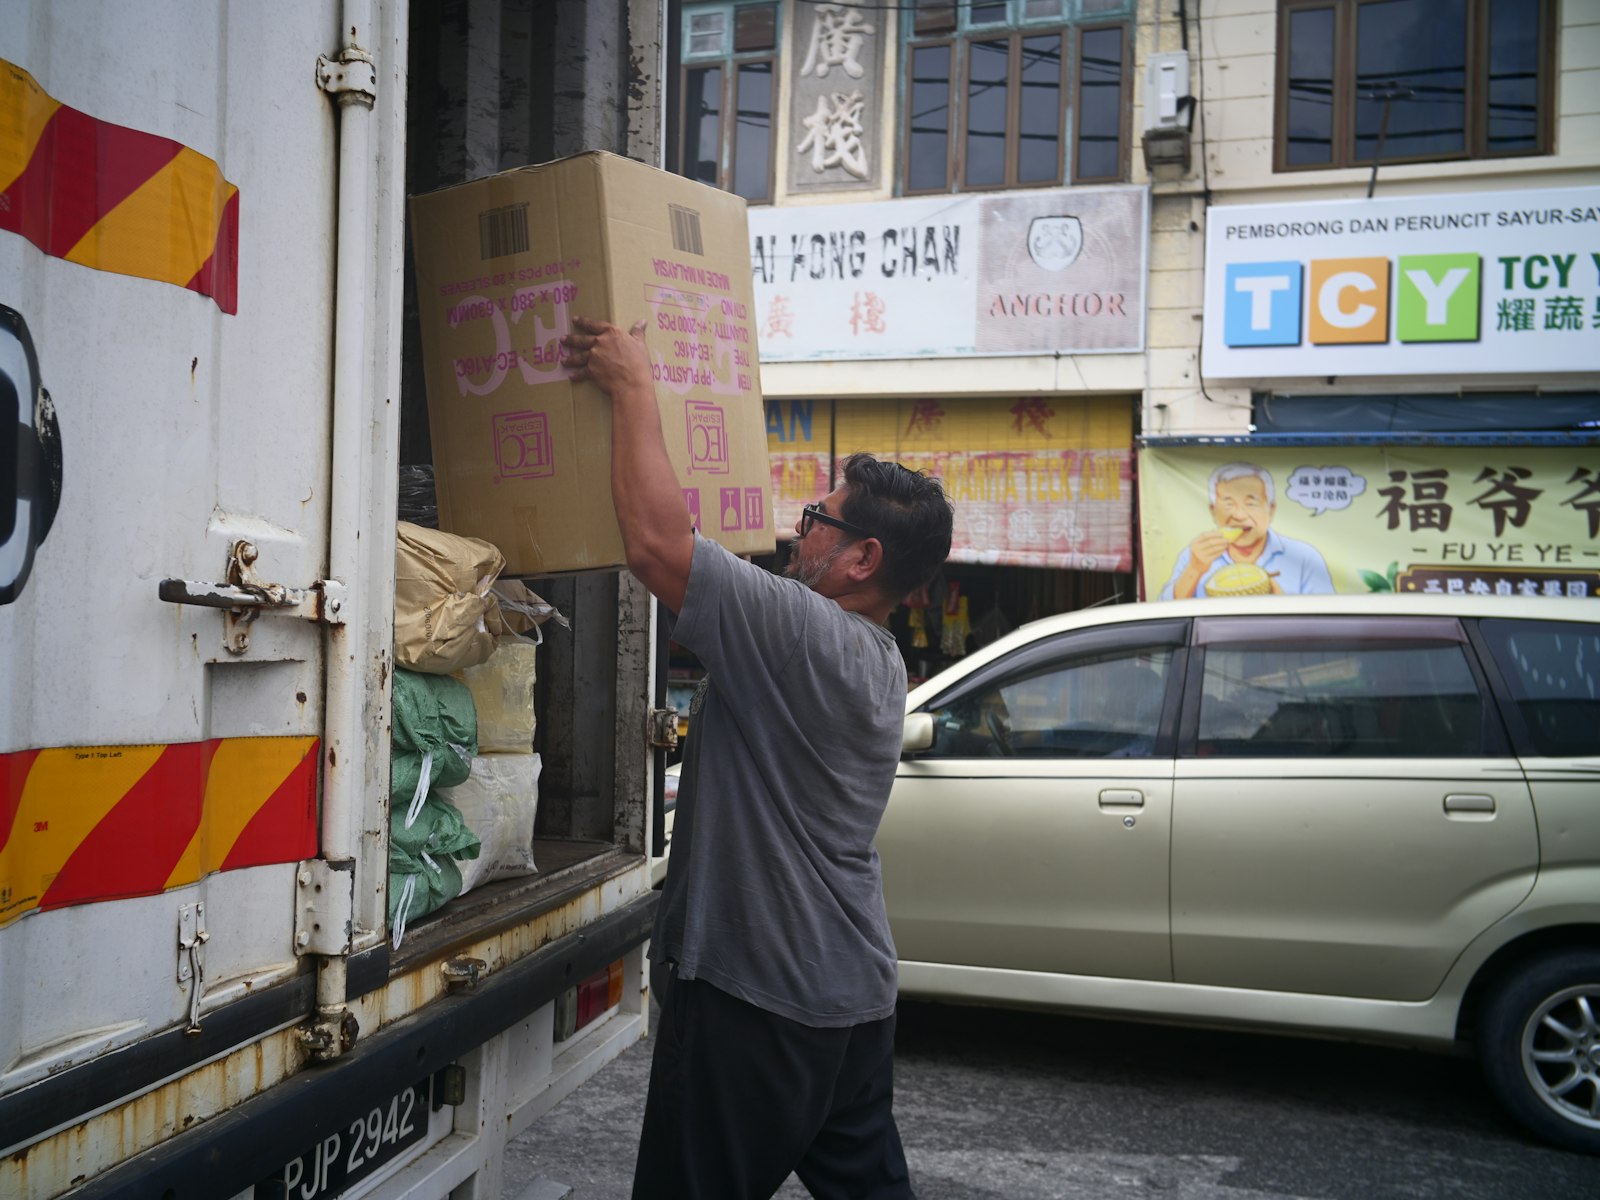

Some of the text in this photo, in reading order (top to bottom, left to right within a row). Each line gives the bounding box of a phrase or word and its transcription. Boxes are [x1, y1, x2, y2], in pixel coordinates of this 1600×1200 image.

[1226, 207, 1600, 240] PEMBORONG DAN PERUNCIT SAYUR-SA
[881, 225, 960, 278] CHAN
[519, 267, 542, 281] PCS
[652, 257, 697, 283] MALAYSIA
[1498, 254, 1577, 290] TCY
[440, 277, 490, 297] SLEEVES
[707, 270, 730, 291] MADE
[511, 292, 536, 312] 380
[553, 285, 578, 305] 480
[657, 312, 677, 332] PCS
[1497, 296, 1600, 332] 耀蔬
[678, 316, 697, 334] 2000
[715, 322, 749, 343] QUANTITY
[734, 349, 750, 367] TYPE
[662, 364, 699, 384] PLASTIC
[502, 432, 544, 470] EC
[693, 424, 722, 462] EC
[1442, 543, 1572, 562] FU YE YE
[34, 821, 48, 832] 3M
[285, 1086, 415, 1200] PJP 2942
